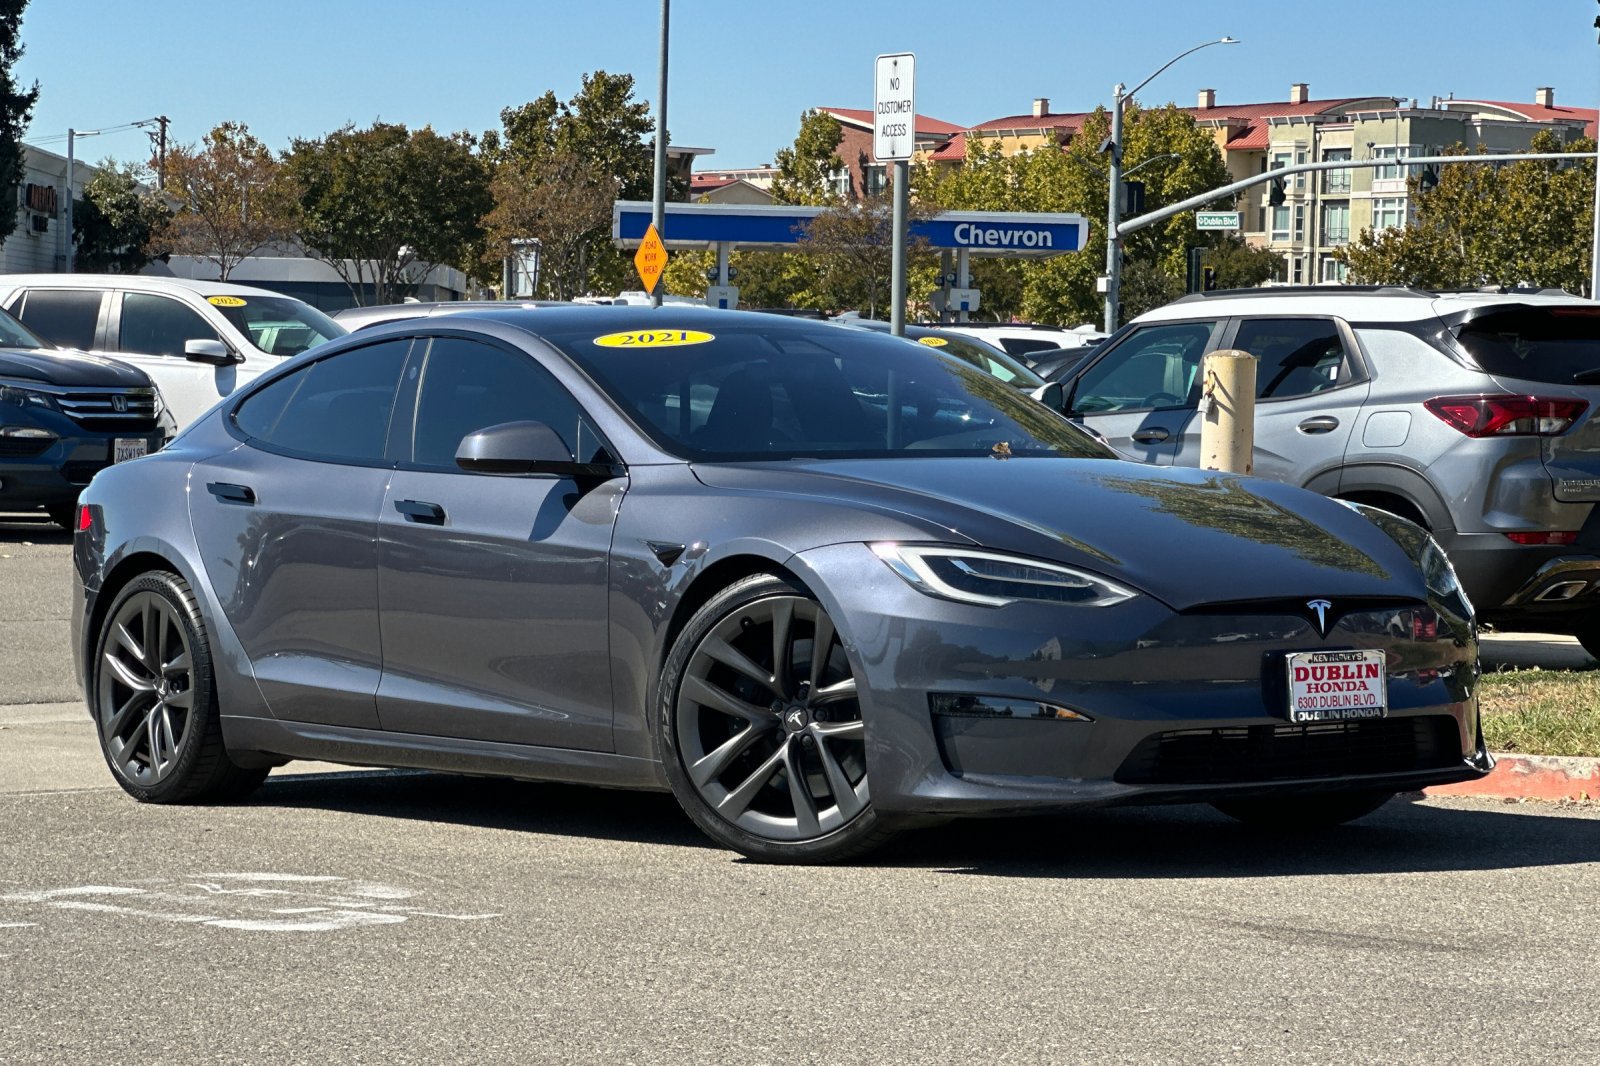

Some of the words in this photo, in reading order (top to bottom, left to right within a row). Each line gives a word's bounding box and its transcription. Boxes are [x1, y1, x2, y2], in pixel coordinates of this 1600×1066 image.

[889, 77, 901, 91] NO
[877, 99, 912, 115] CUSTOMER
[881, 123, 907, 138] ACCESS
[1203, 217, 1223, 225] Dublin
[1223, 217, 1237, 225] Blvd
[953, 223, 1053, 247] Chevron
[619, 331, 687, 345] 2021
[1313, 654, 1328, 663] KEN
[1329, 652, 1362, 662] HARVEY'S
[1294, 663, 1380, 682] DUBLIN
[1306, 681, 1369, 693] HONDA
[1298, 697, 1318, 709] 6300
[1320, 695, 1352, 708] DUBLIN
[1353, 694, 1378, 706] BLVD.
[1298, 711, 1341, 721] DUBLIN
[1342, 708, 1381, 719] HONDA
